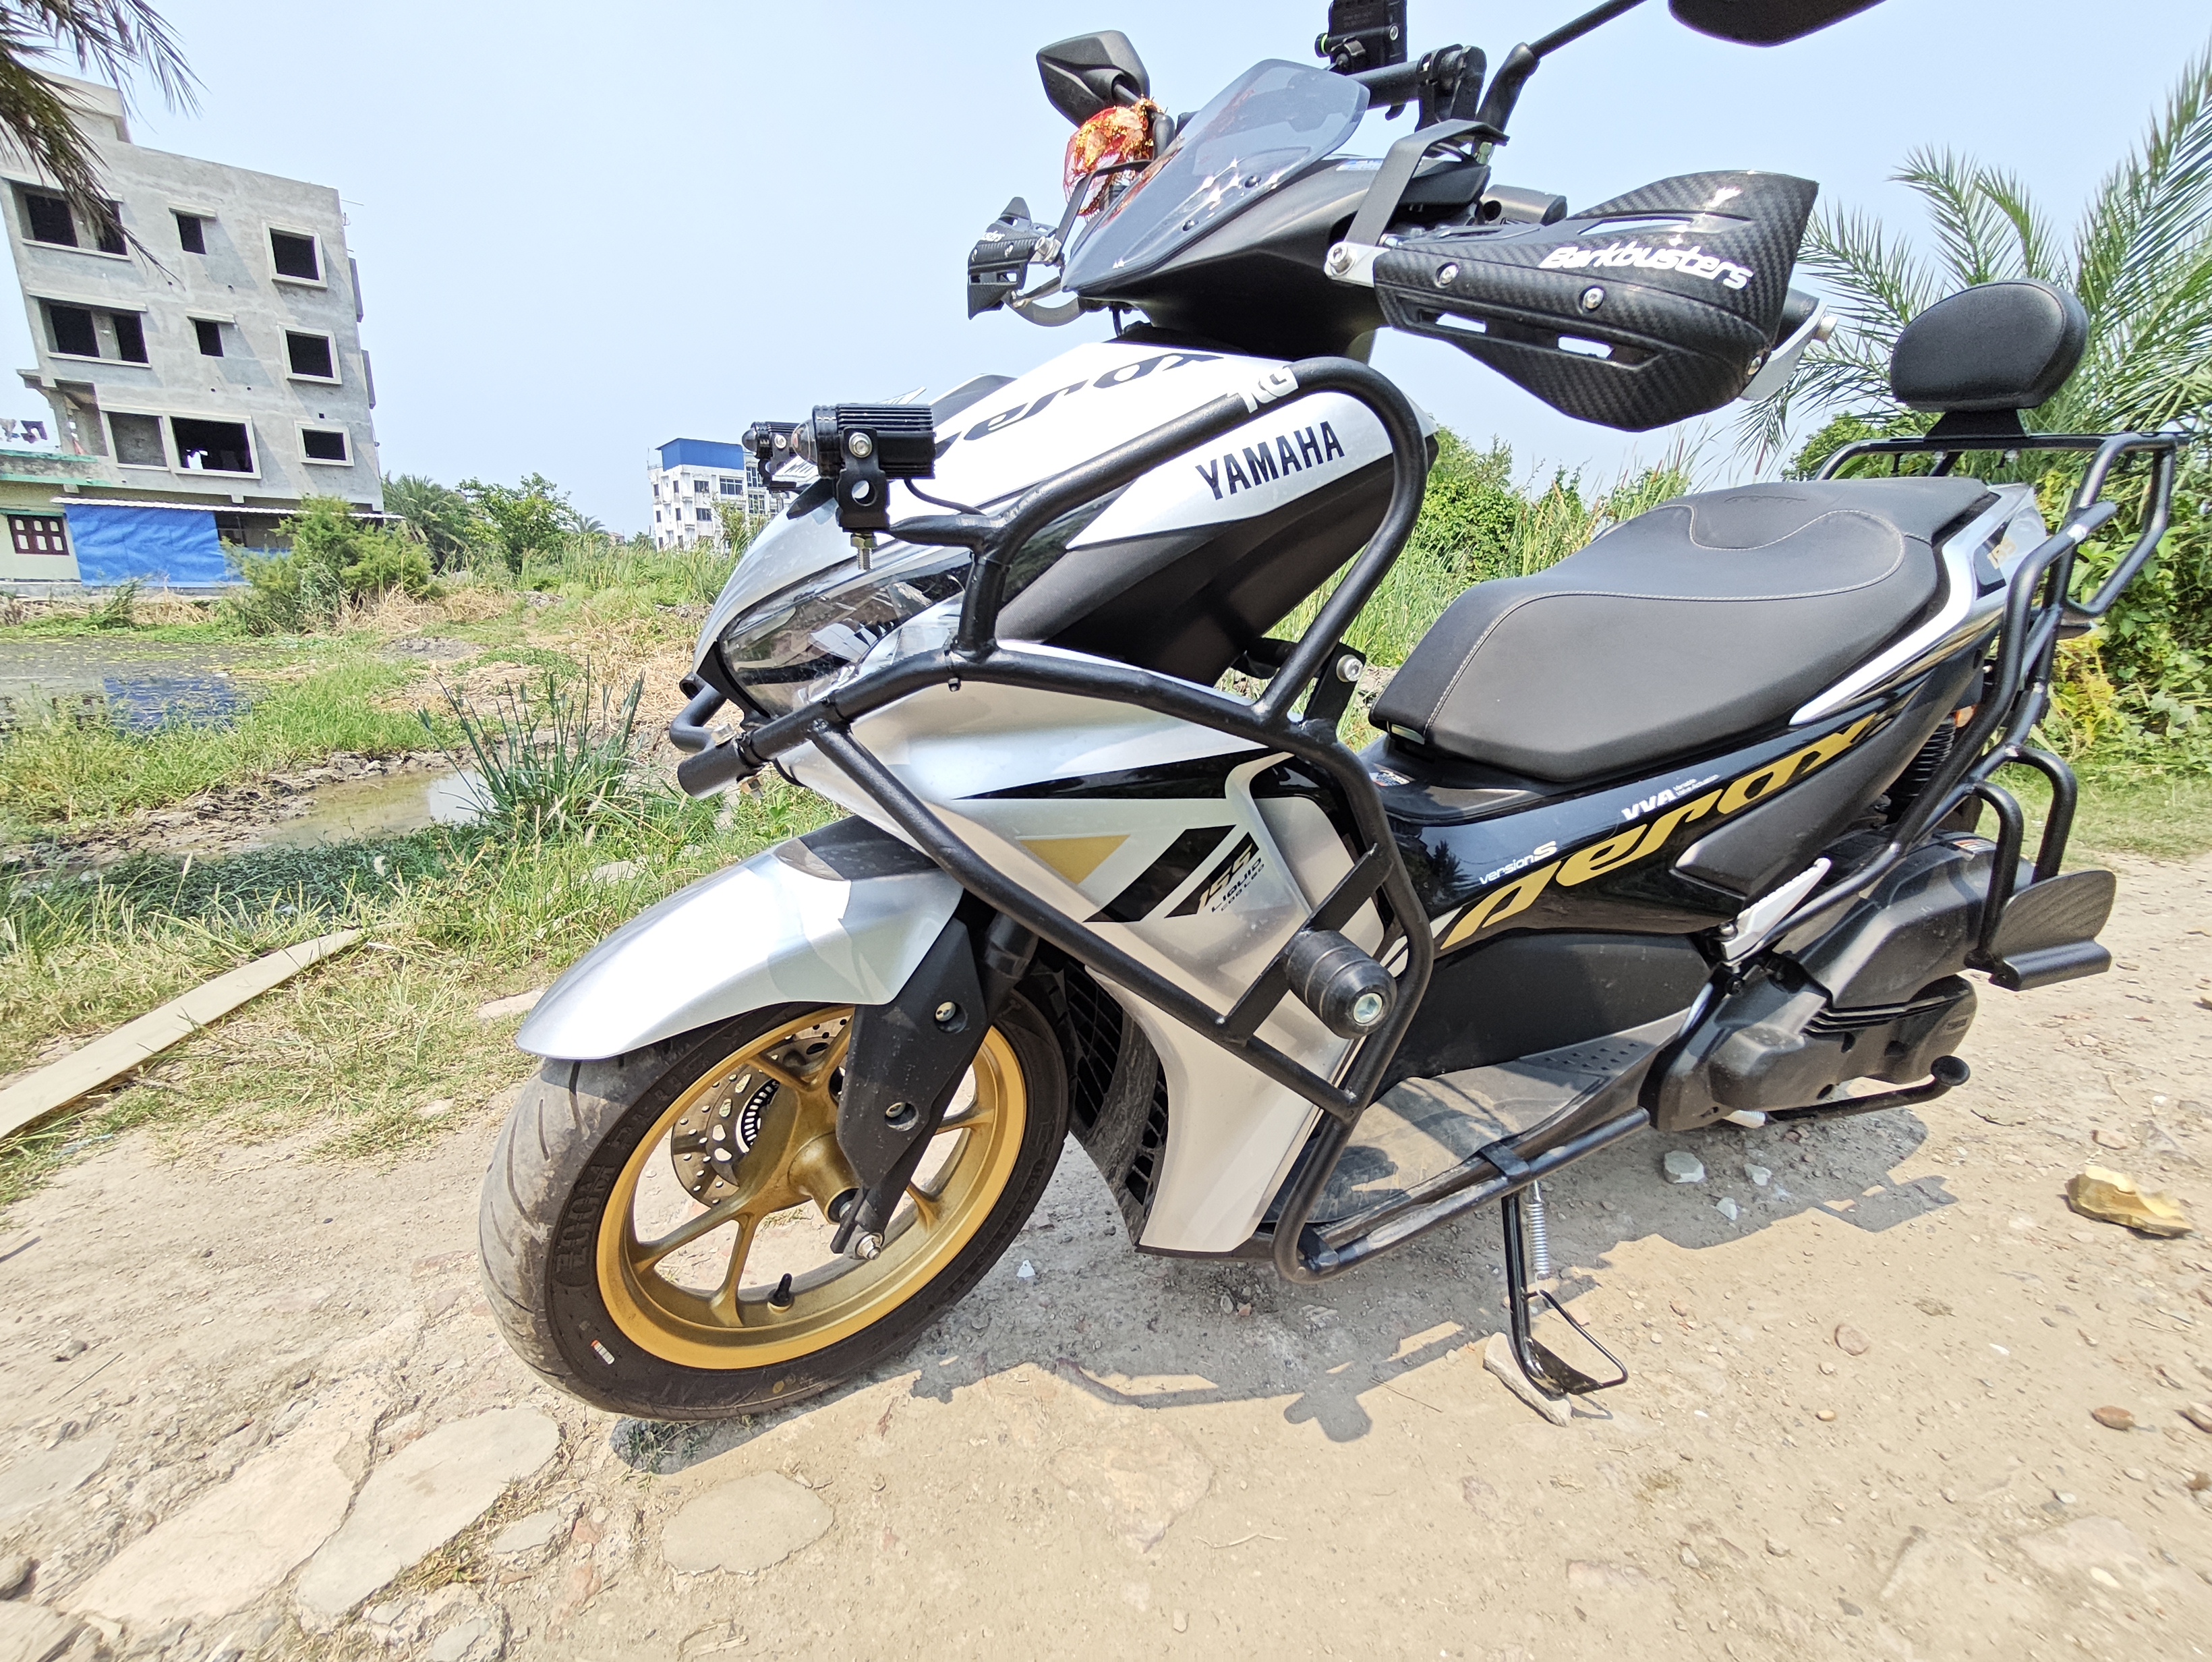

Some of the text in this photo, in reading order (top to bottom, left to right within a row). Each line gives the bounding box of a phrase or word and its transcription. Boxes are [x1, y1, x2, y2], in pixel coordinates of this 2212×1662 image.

[1538, 241, 1753, 290] Barkbusters
[1195, 421, 1345, 500] YAMAHA
[1621, 789, 1677, 820] VVA
[1199, 842, 1253, 911] 155
[1211, 857, 1262, 913] LIQUID
